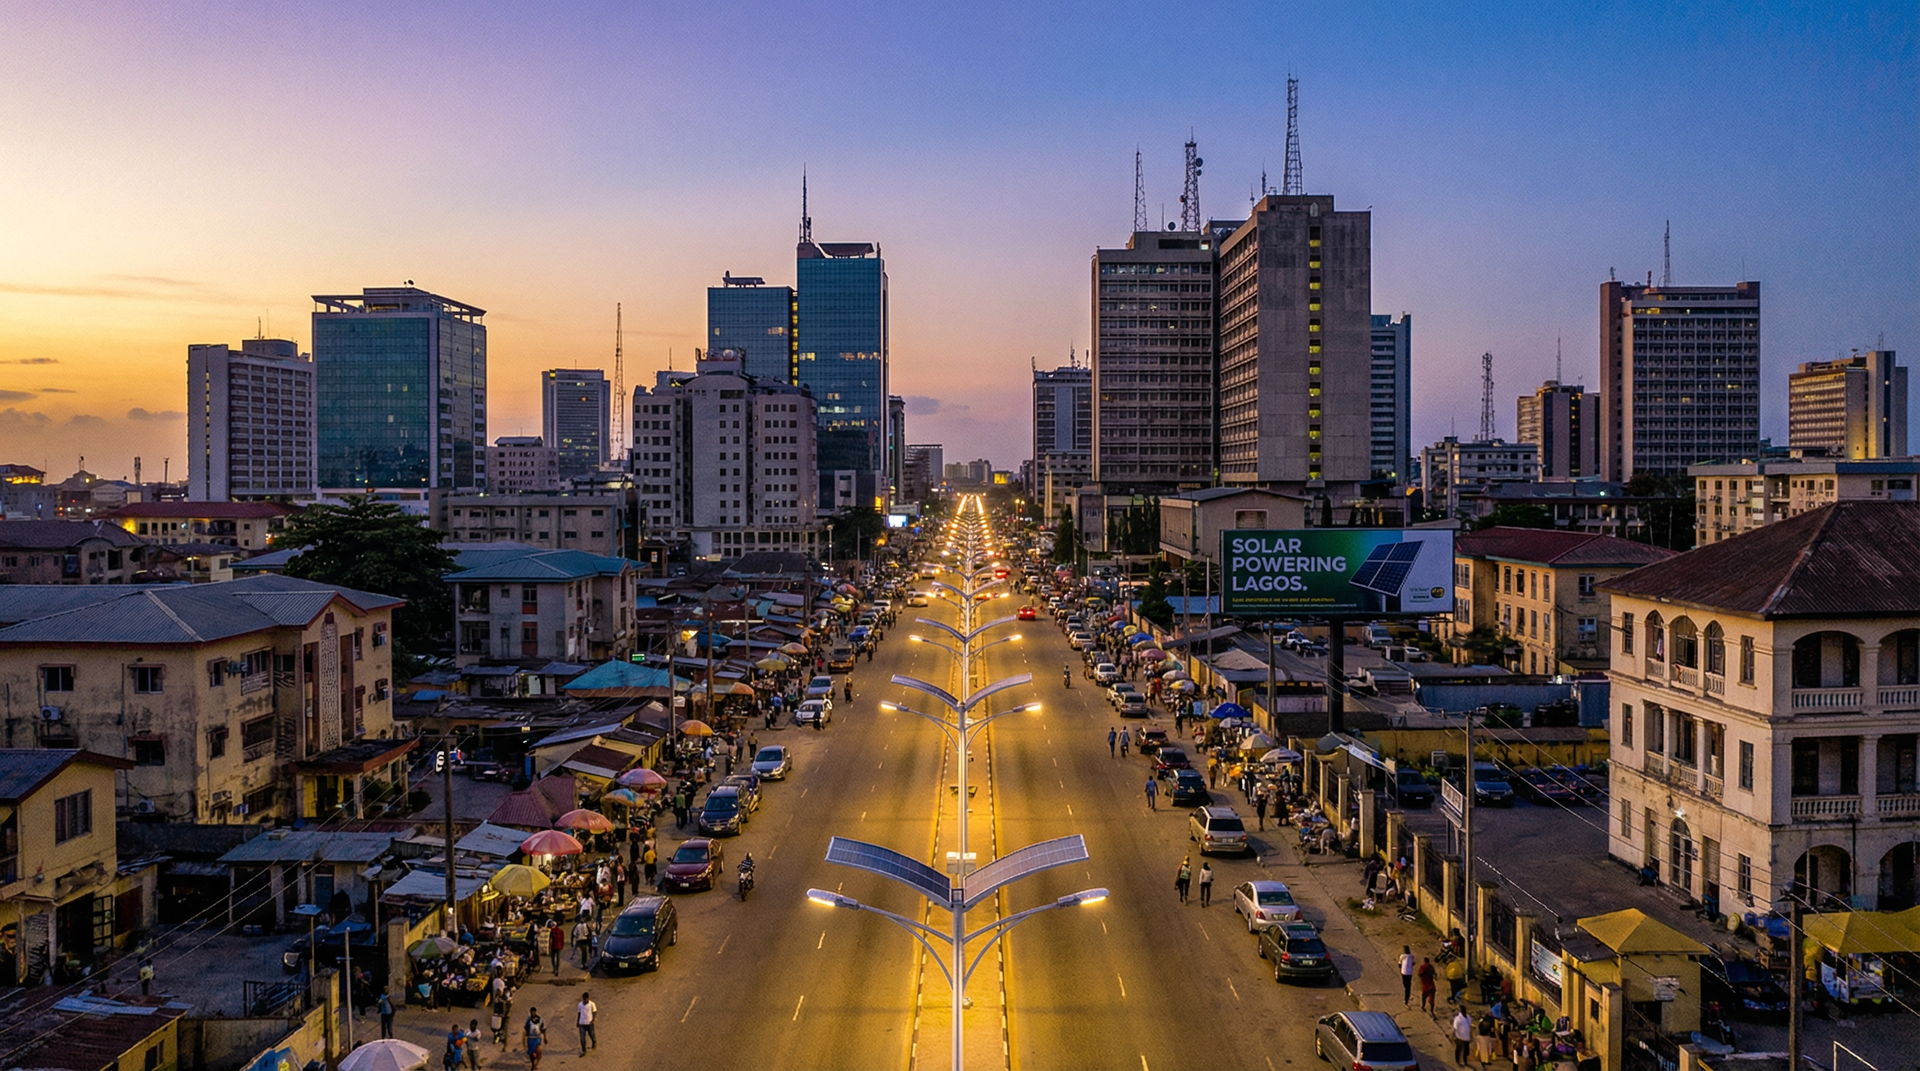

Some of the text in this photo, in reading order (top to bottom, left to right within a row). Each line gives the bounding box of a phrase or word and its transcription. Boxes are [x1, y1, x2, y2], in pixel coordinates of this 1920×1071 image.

[1232, 538, 1302, 554] SOLAR
[1232, 556, 1347, 572] POWERING
[1232, 575, 1308, 591] LAGOS.
